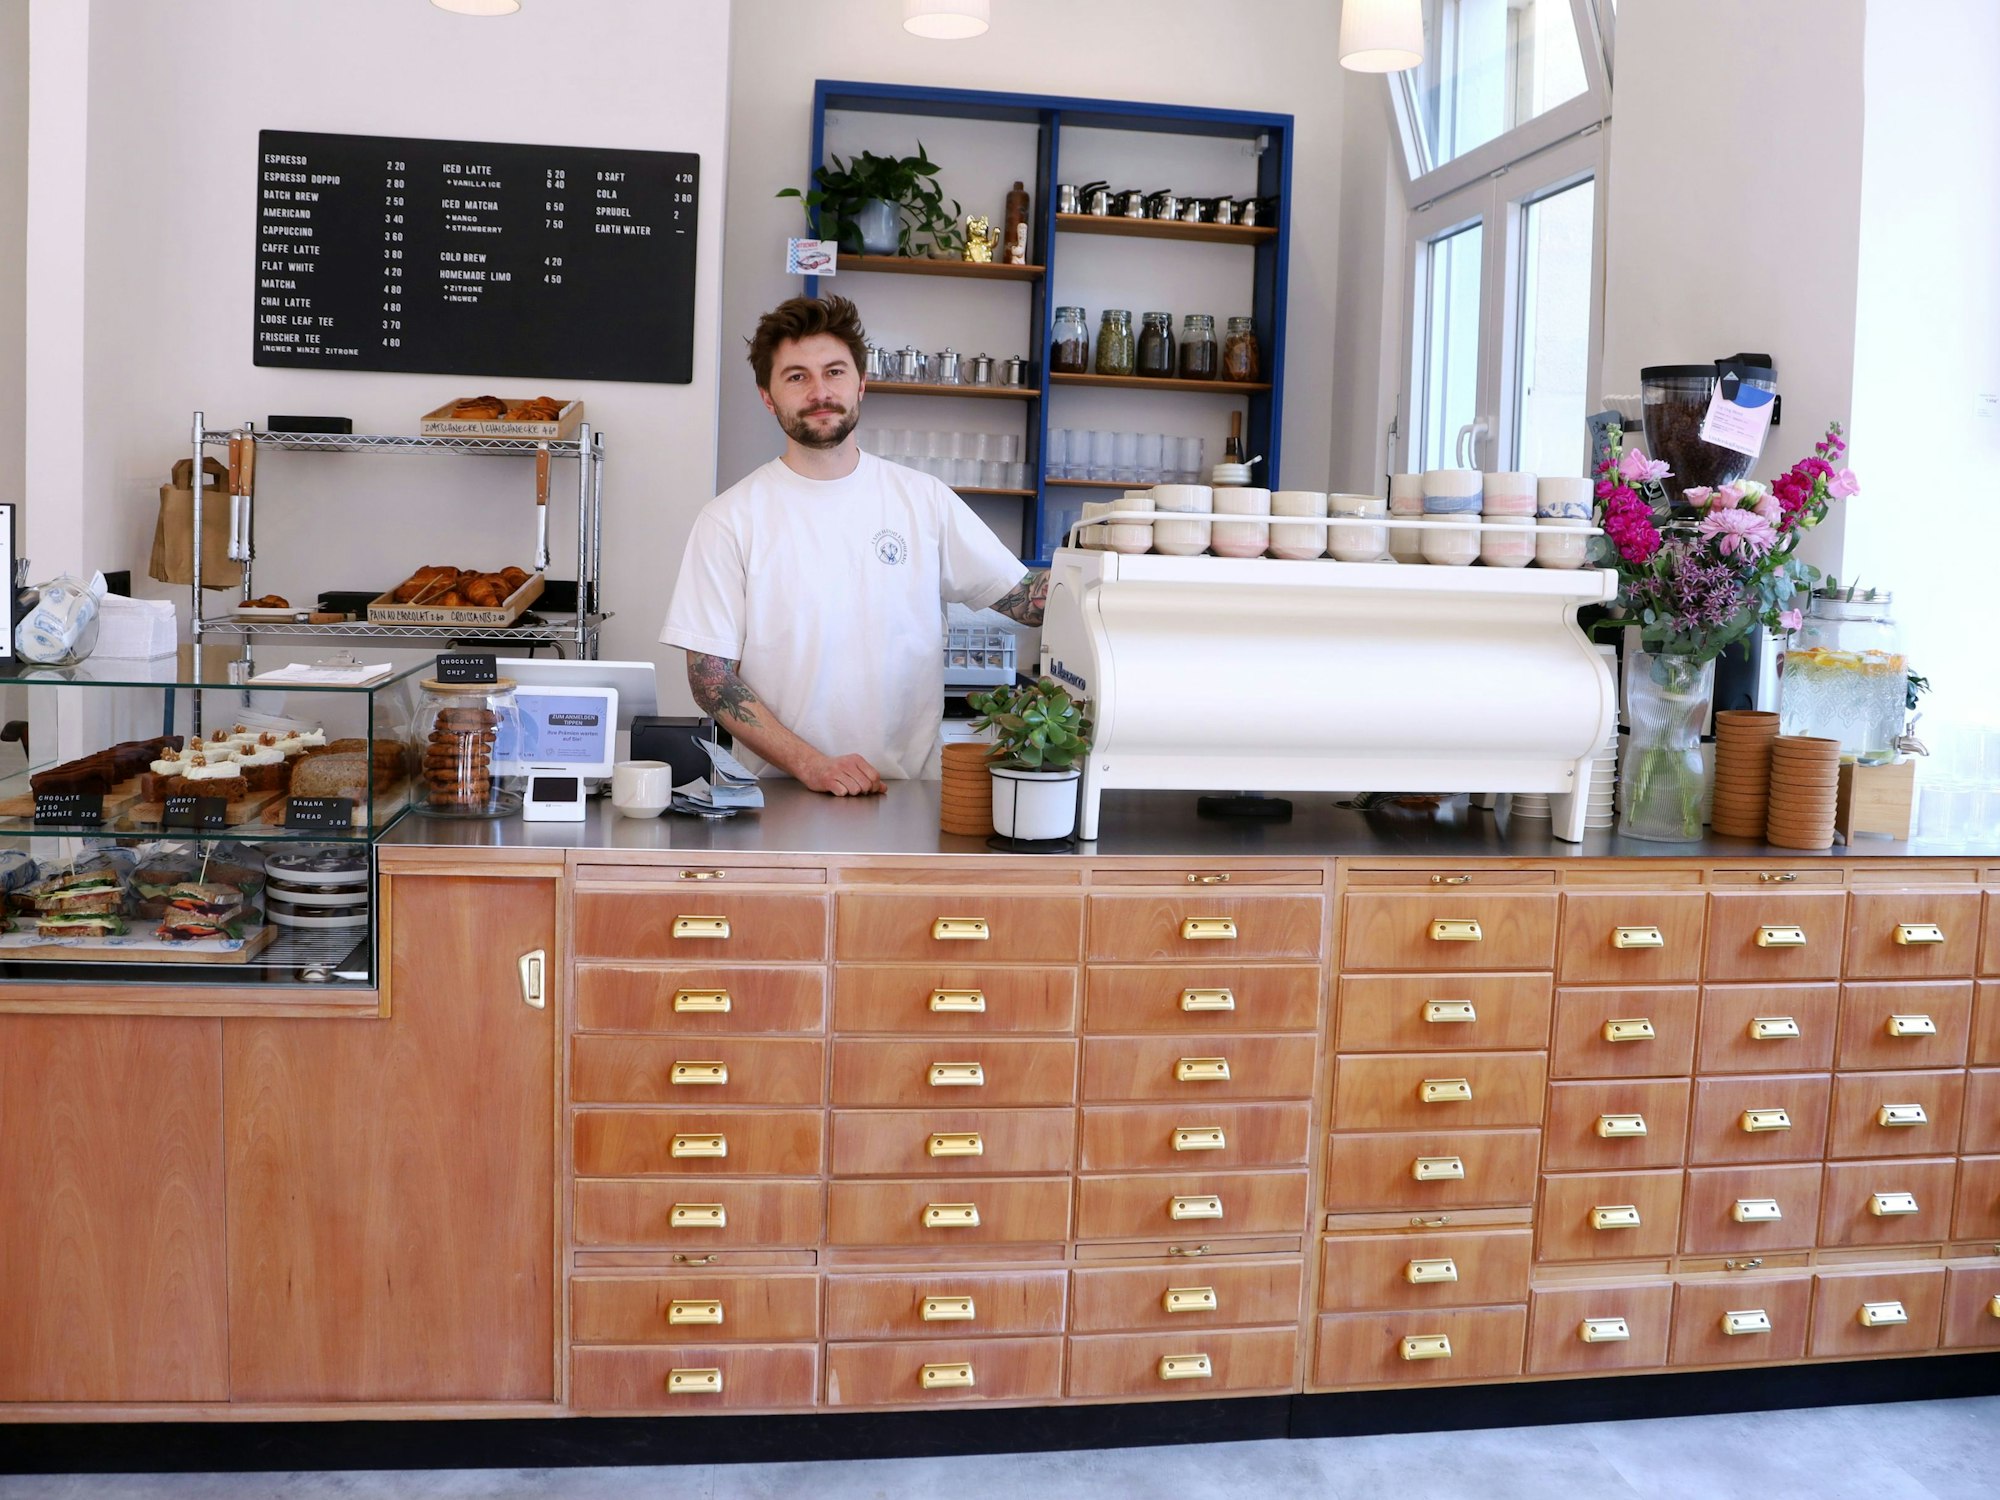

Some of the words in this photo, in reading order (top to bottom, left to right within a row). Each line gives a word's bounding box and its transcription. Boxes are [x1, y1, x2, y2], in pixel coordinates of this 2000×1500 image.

[265, 154, 307, 165] ESPRESSO
[443, 164, 461, 174] ICED
[466, 165, 491, 175] LATTE
[264, 172, 306, 183] ESPRESSO
[311, 174, 340, 185] DOPPIO
[605, 172, 625, 182] SAFT
[264, 189, 291, 200] BATCH
[295, 191, 319, 202] BREW
[596, 189, 617, 199] COLA
[442, 199, 460, 209] ICED
[465, 200, 498, 211] MATCHA
[263, 207, 311, 219] AMERICANO
[596, 206, 631, 217] SPRUDEL
[674, 210, 679, 220] 2
[263, 225, 313, 237] CAPPUCCINO
[595, 224, 621, 234] EARTH
[623, 225, 651, 235] WATER
[262, 243, 289, 253] CAFFE
[293, 245, 320, 255] LATTE
[440, 252, 461, 262] COLD
[463, 253, 487, 263] BREW
[262, 261, 283, 271] FLAT
[288, 262, 314, 273] WHITE
[440, 269, 486, 280] HOMEMADE
[490, 272, 511, 281] LIMO
[261, 279, 296, 289] MATCHA
[261, 296, 280, 306] CHAI
[285, 298, 311, 308] LATTE
[260, 314, 287, 324] LOOSE
[292, 316, 313, 325] LEAF
[318, 317, 334, 326] TEE
[260, 332, 300, 342] FRISCHER
[305, 334, 320, 344] TEE
[296, 346, 320, 354] MINZE
[325, 347, 358, 355] ZITRONE
[370, 610, 386, 620] PAIN
[388, 611, 395, 620] AU
[397, 610, 430, 621] CHOCOLAT
[166, 798, 196, 806] CARROT
[35, 811, 72, 819] BROWNIE
